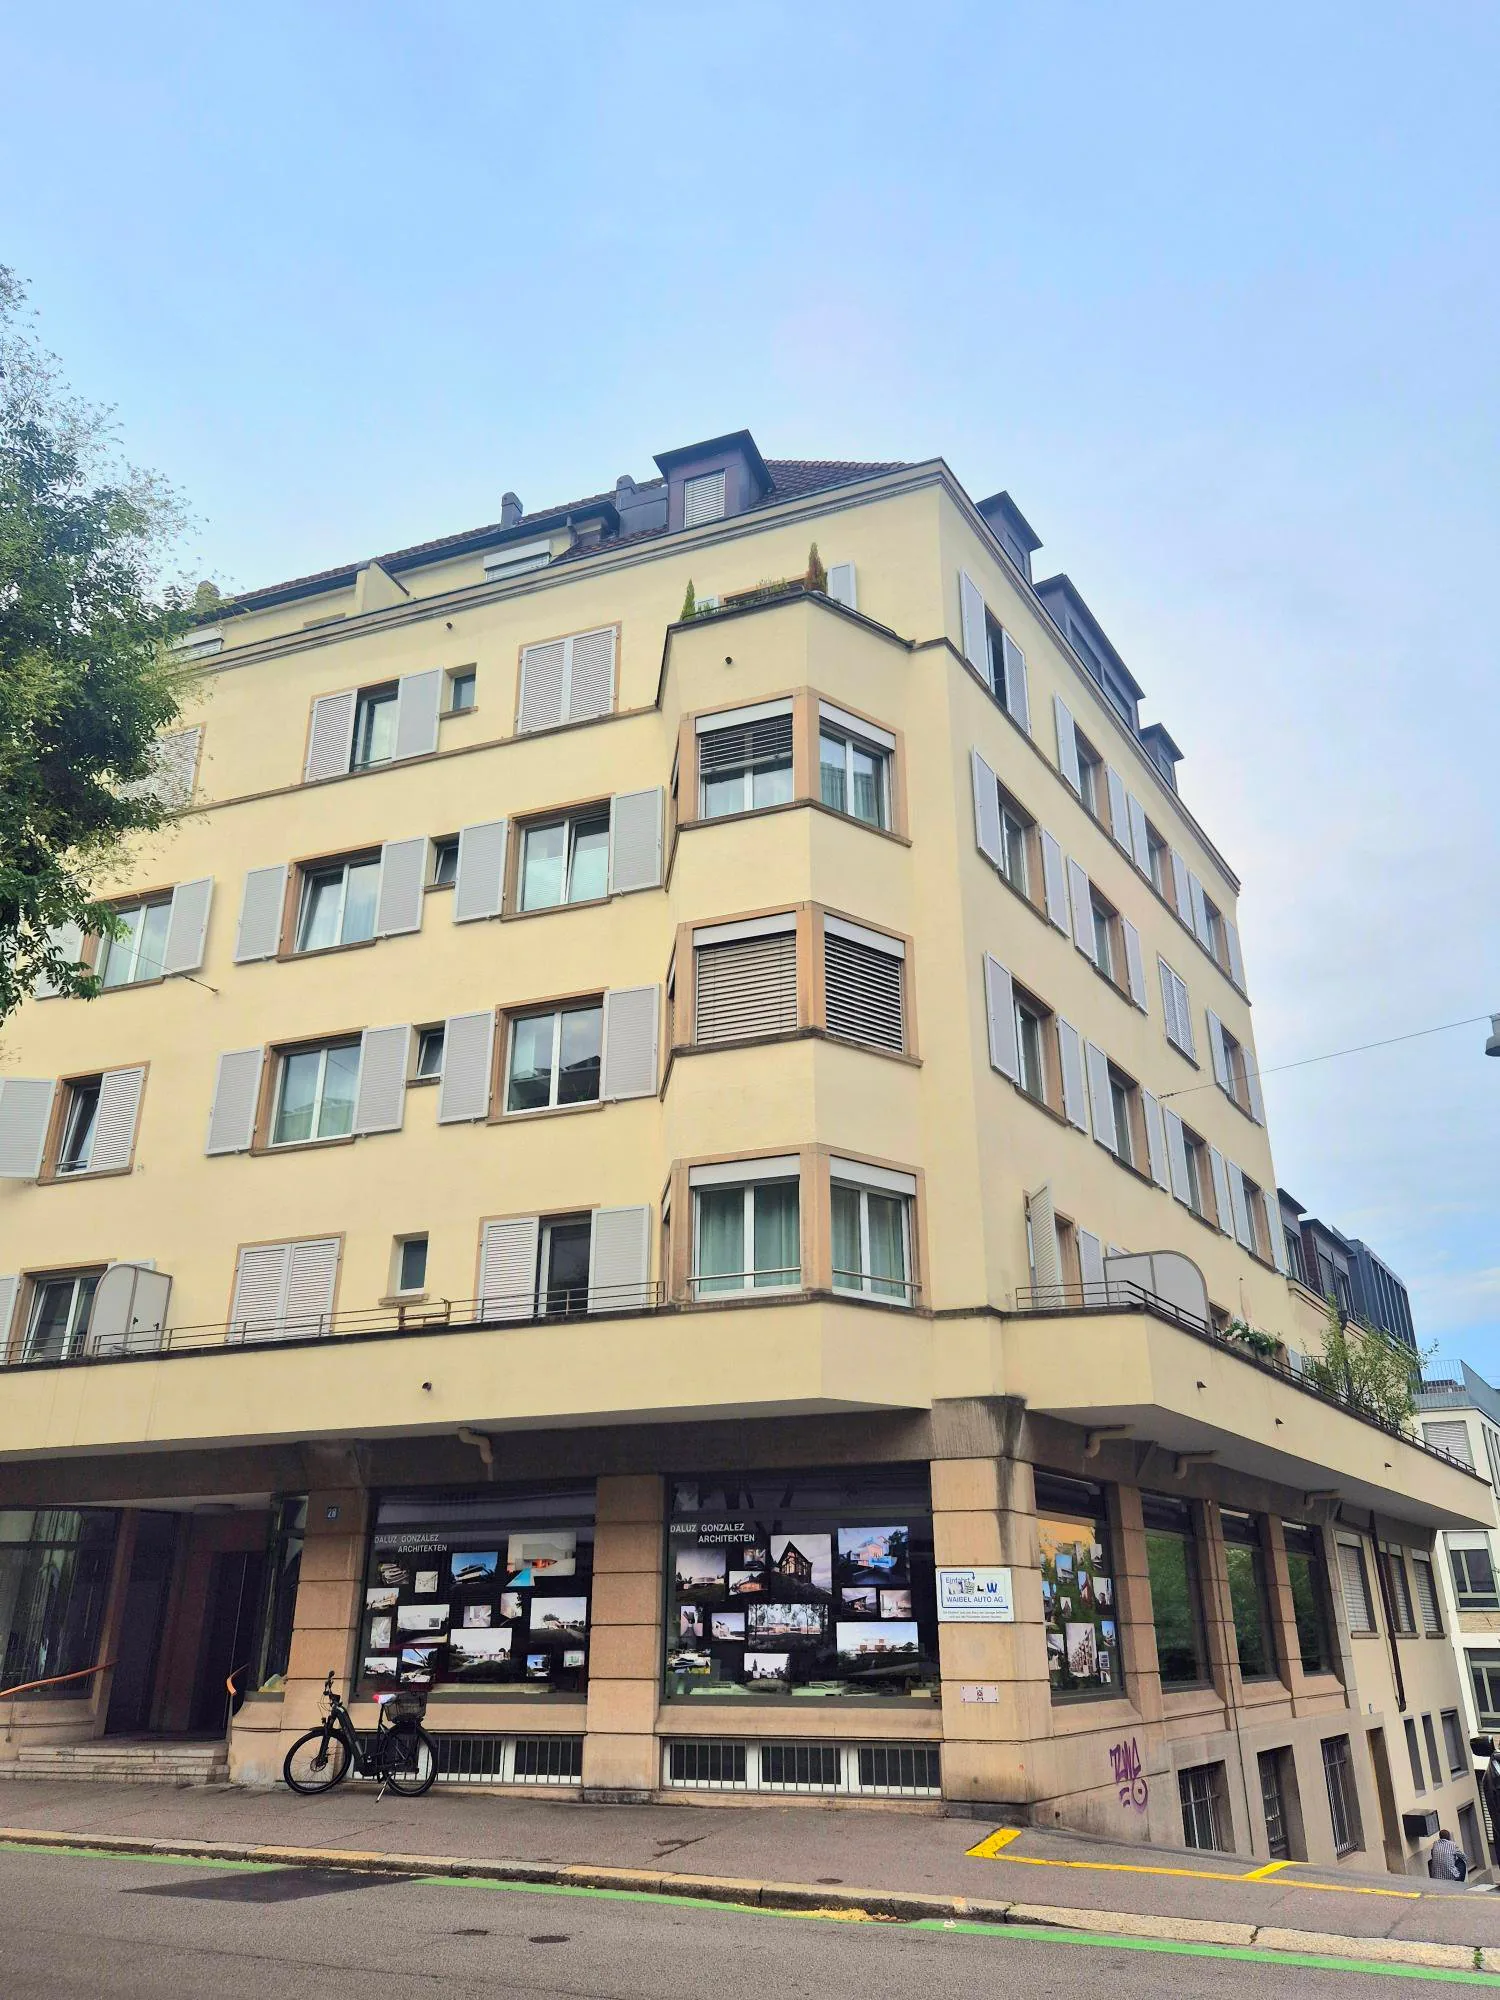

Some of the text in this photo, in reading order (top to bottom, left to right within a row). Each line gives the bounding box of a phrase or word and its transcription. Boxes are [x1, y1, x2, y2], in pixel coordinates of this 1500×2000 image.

[669, 1523, 745, 1533] DALUZ GONZALEZ
[374, 1533, 440, 1544] DALUZ GONZALEZ
[698, 1534, 755, 1543] ARCHITEKTEN
[398, 1544, 448, 1553] ARCHITEKTEN
